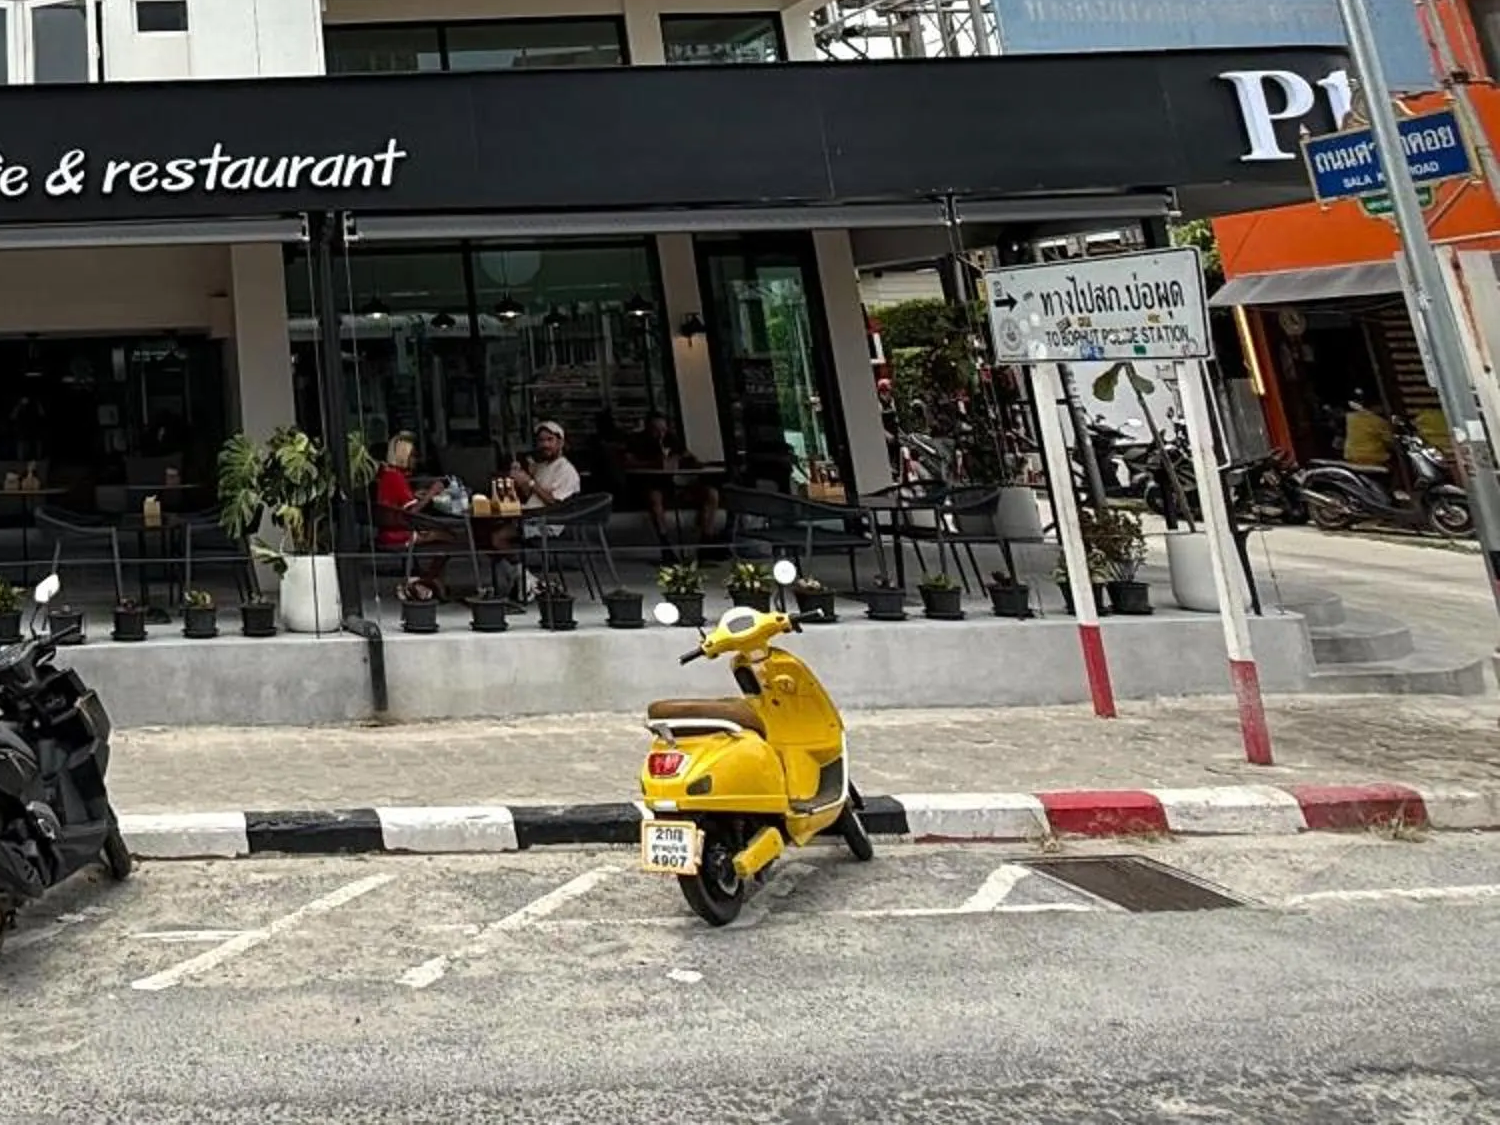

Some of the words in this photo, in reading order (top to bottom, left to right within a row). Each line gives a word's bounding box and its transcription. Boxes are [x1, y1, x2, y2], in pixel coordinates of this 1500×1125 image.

[44, 148, 86, 196] &
[101, 138, 407, 194] restaurant
[1343, 174, 1373, 189] SALA
[1046, 330, 1061, 348] TO
[1141, 324, 1190, 344] STATION
[651, 854, 688, 869] 4907
